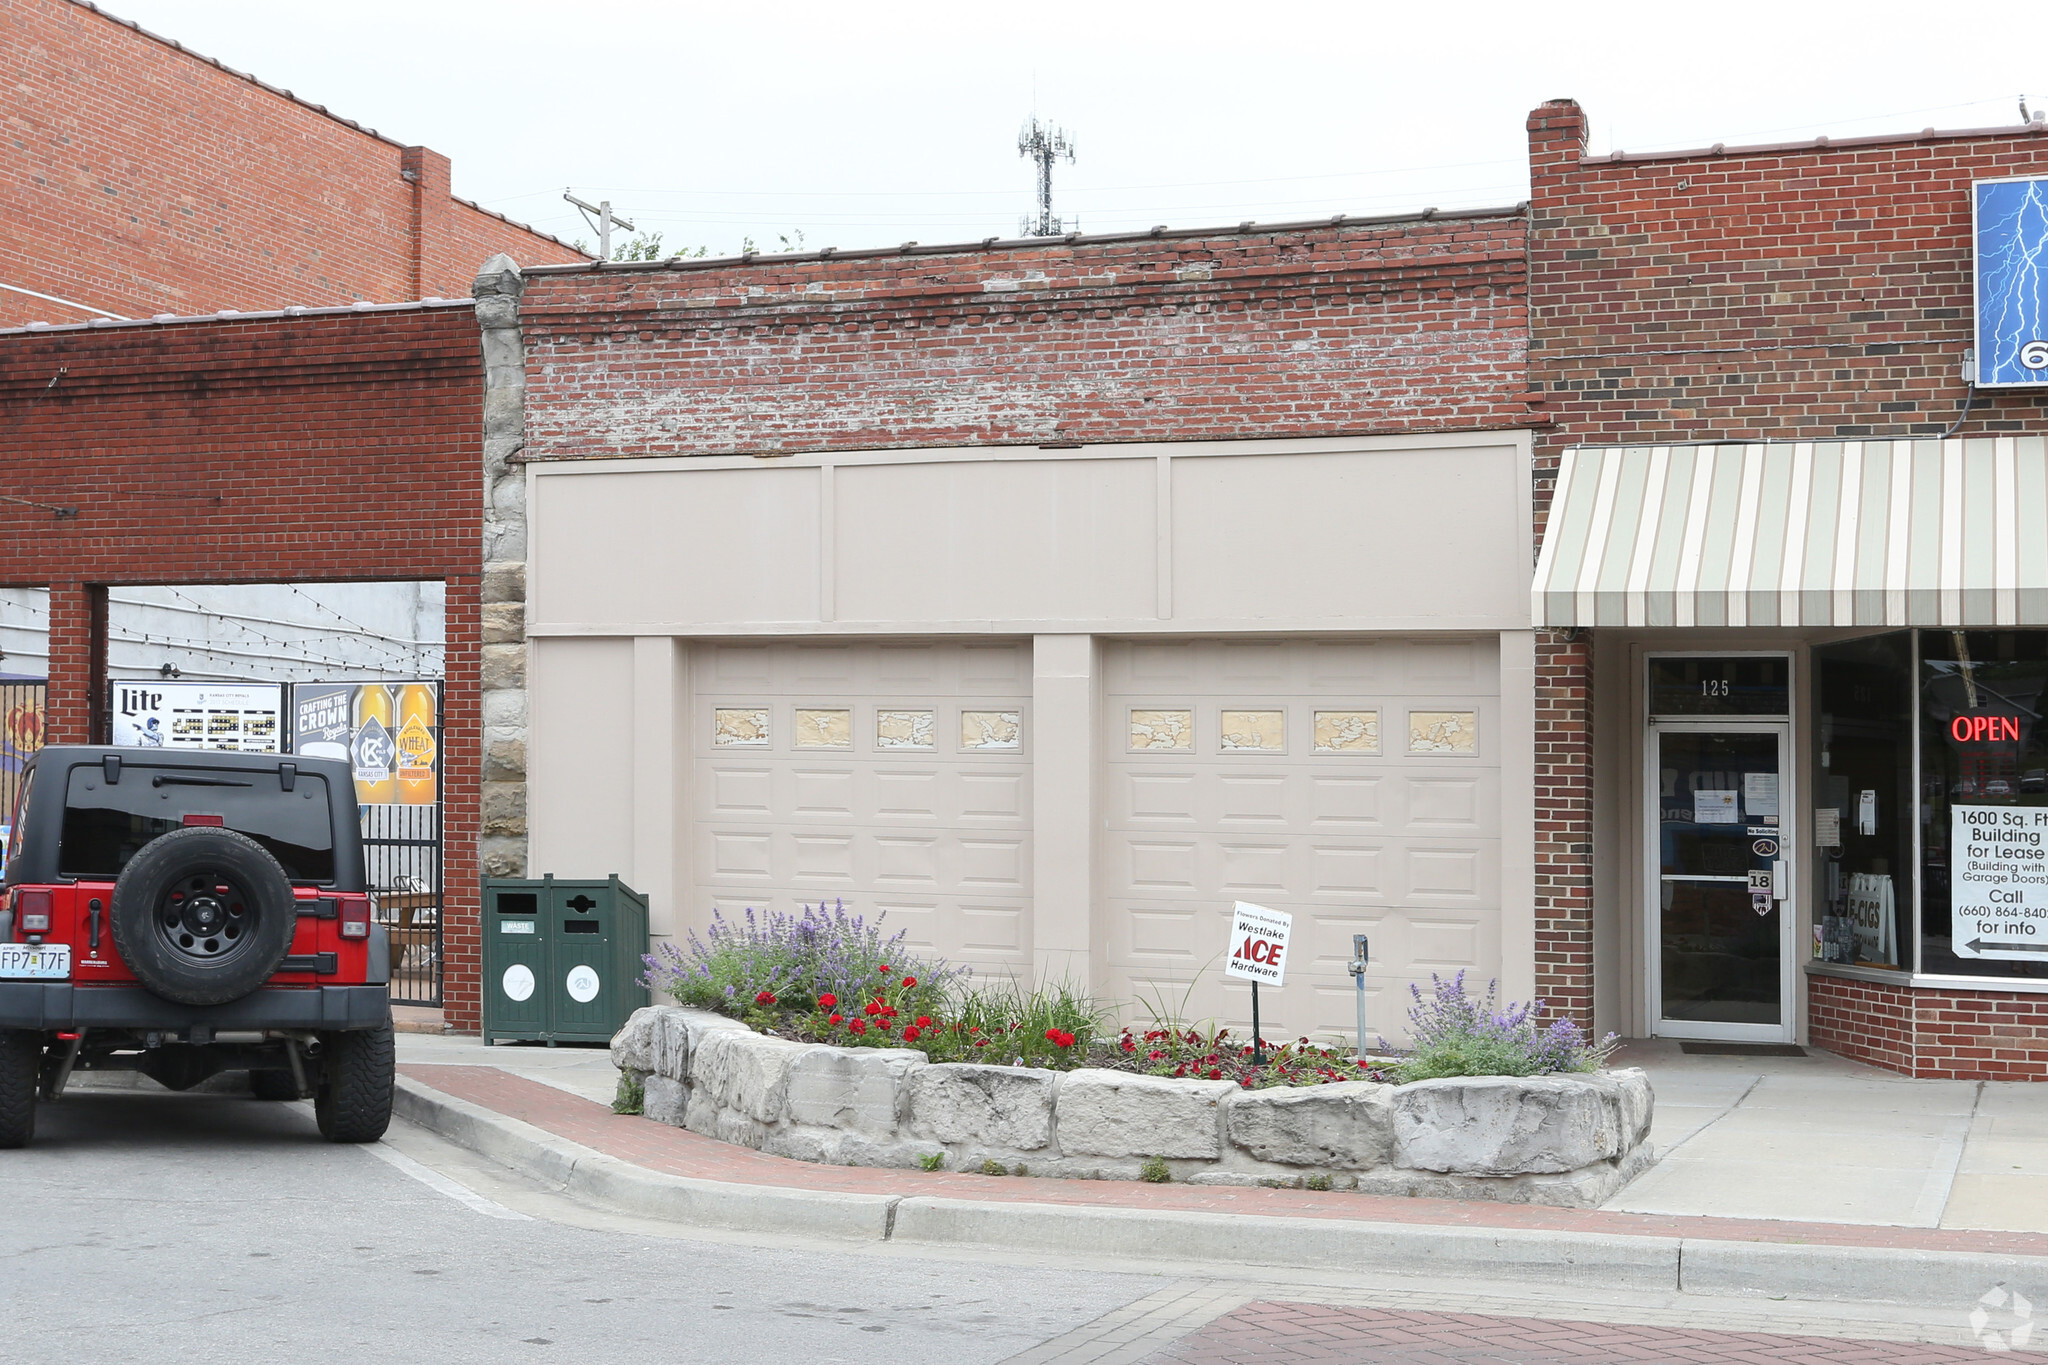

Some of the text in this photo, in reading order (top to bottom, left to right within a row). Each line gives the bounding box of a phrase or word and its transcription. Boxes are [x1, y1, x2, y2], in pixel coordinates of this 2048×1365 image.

[1702, 679, 1729, 697] 125
[120, 688, 162, 717] Lite
[299, 693, 347, 715] CRAFTING THE
[299, 704, 347, 732] CROWN
[322, 722, 348, 741] Royals
[1951, 715, 2020, 742] OPEN
[399, 736, 429, 752] WHEAT
[1961, 811, 1998, 825] 1600
[2002, 812, 2028, 829] Sq.
[1972, 828, 2041, 846] Building
[1967, 844, 2045, 859] for Lease
[1967, 861, 2045, 874] (Building with
[1750, 875, 1770, 888] 18
[1962, 872, 2048, 885] Garage Doors)
[1988, 889, 2023, 904] Call
[1237, 911, 1258, 920] Flowers
[1259, 915, 1281, 925] Donated
[1959, 905, 2048, 919] (660) 864-840
[1238, 921, 1285, 940] Westlake
[1976, 919, 2036, 935] for info
[1233, 935, 1284, 966] ACE
[1, 951, 67, 970] FP7 T7F
[1231, 960, 1278, 977] Hardware
